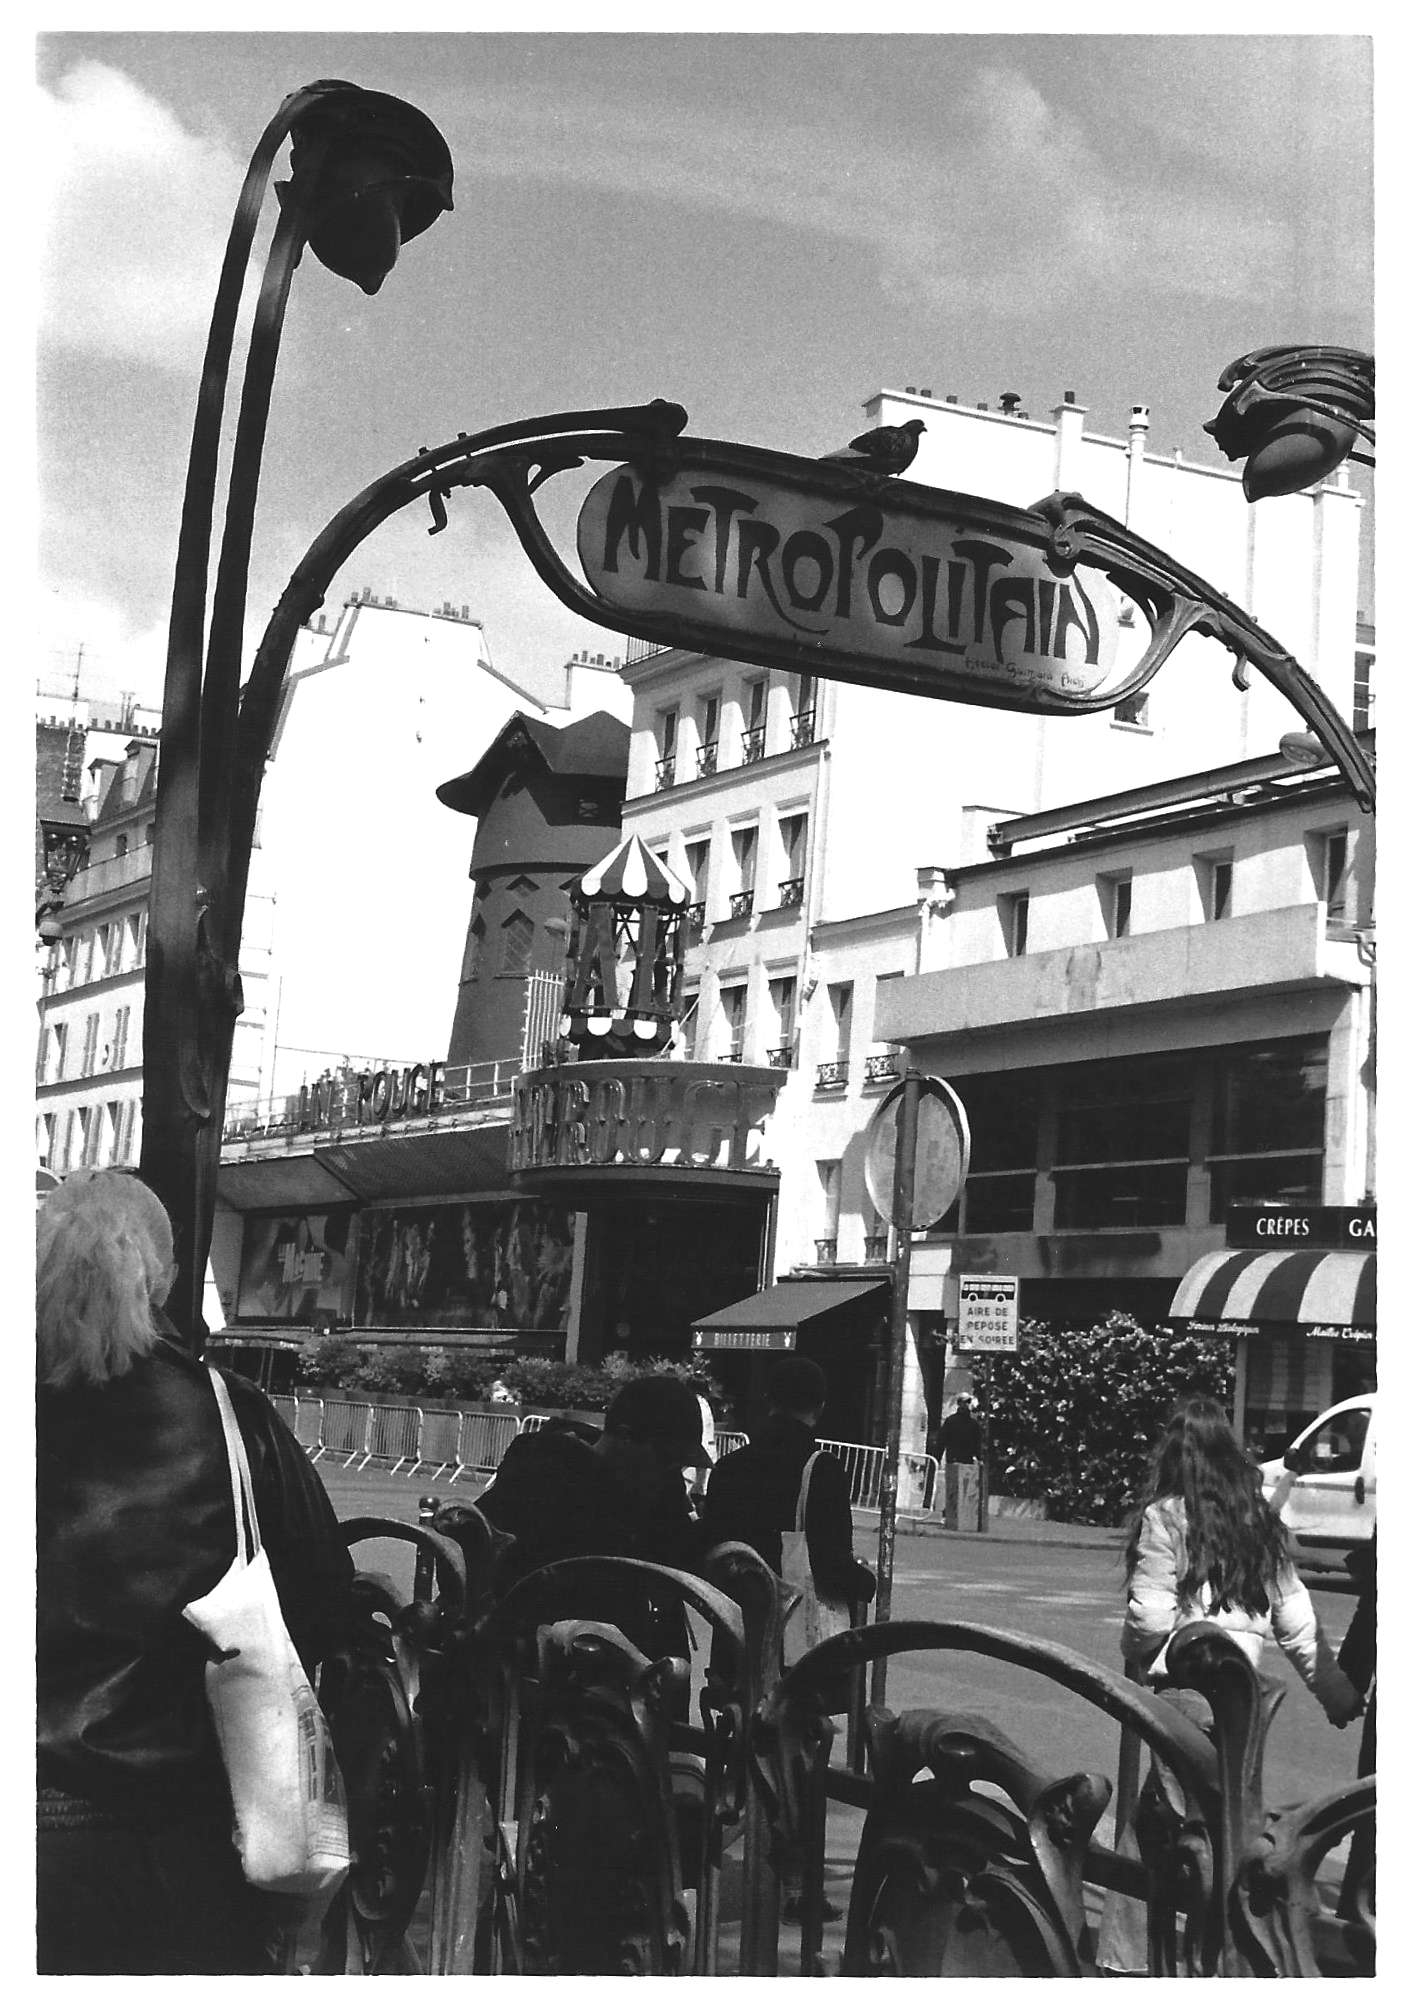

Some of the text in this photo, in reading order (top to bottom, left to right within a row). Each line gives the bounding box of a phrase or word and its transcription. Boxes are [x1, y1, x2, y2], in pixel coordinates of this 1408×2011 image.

[603, 475, 1099, 666] METROPOLITAIN
[1256, 1216, 1310, 1236] CRÊPES
[967, 1306, 1008, 1317] AIRE DE
